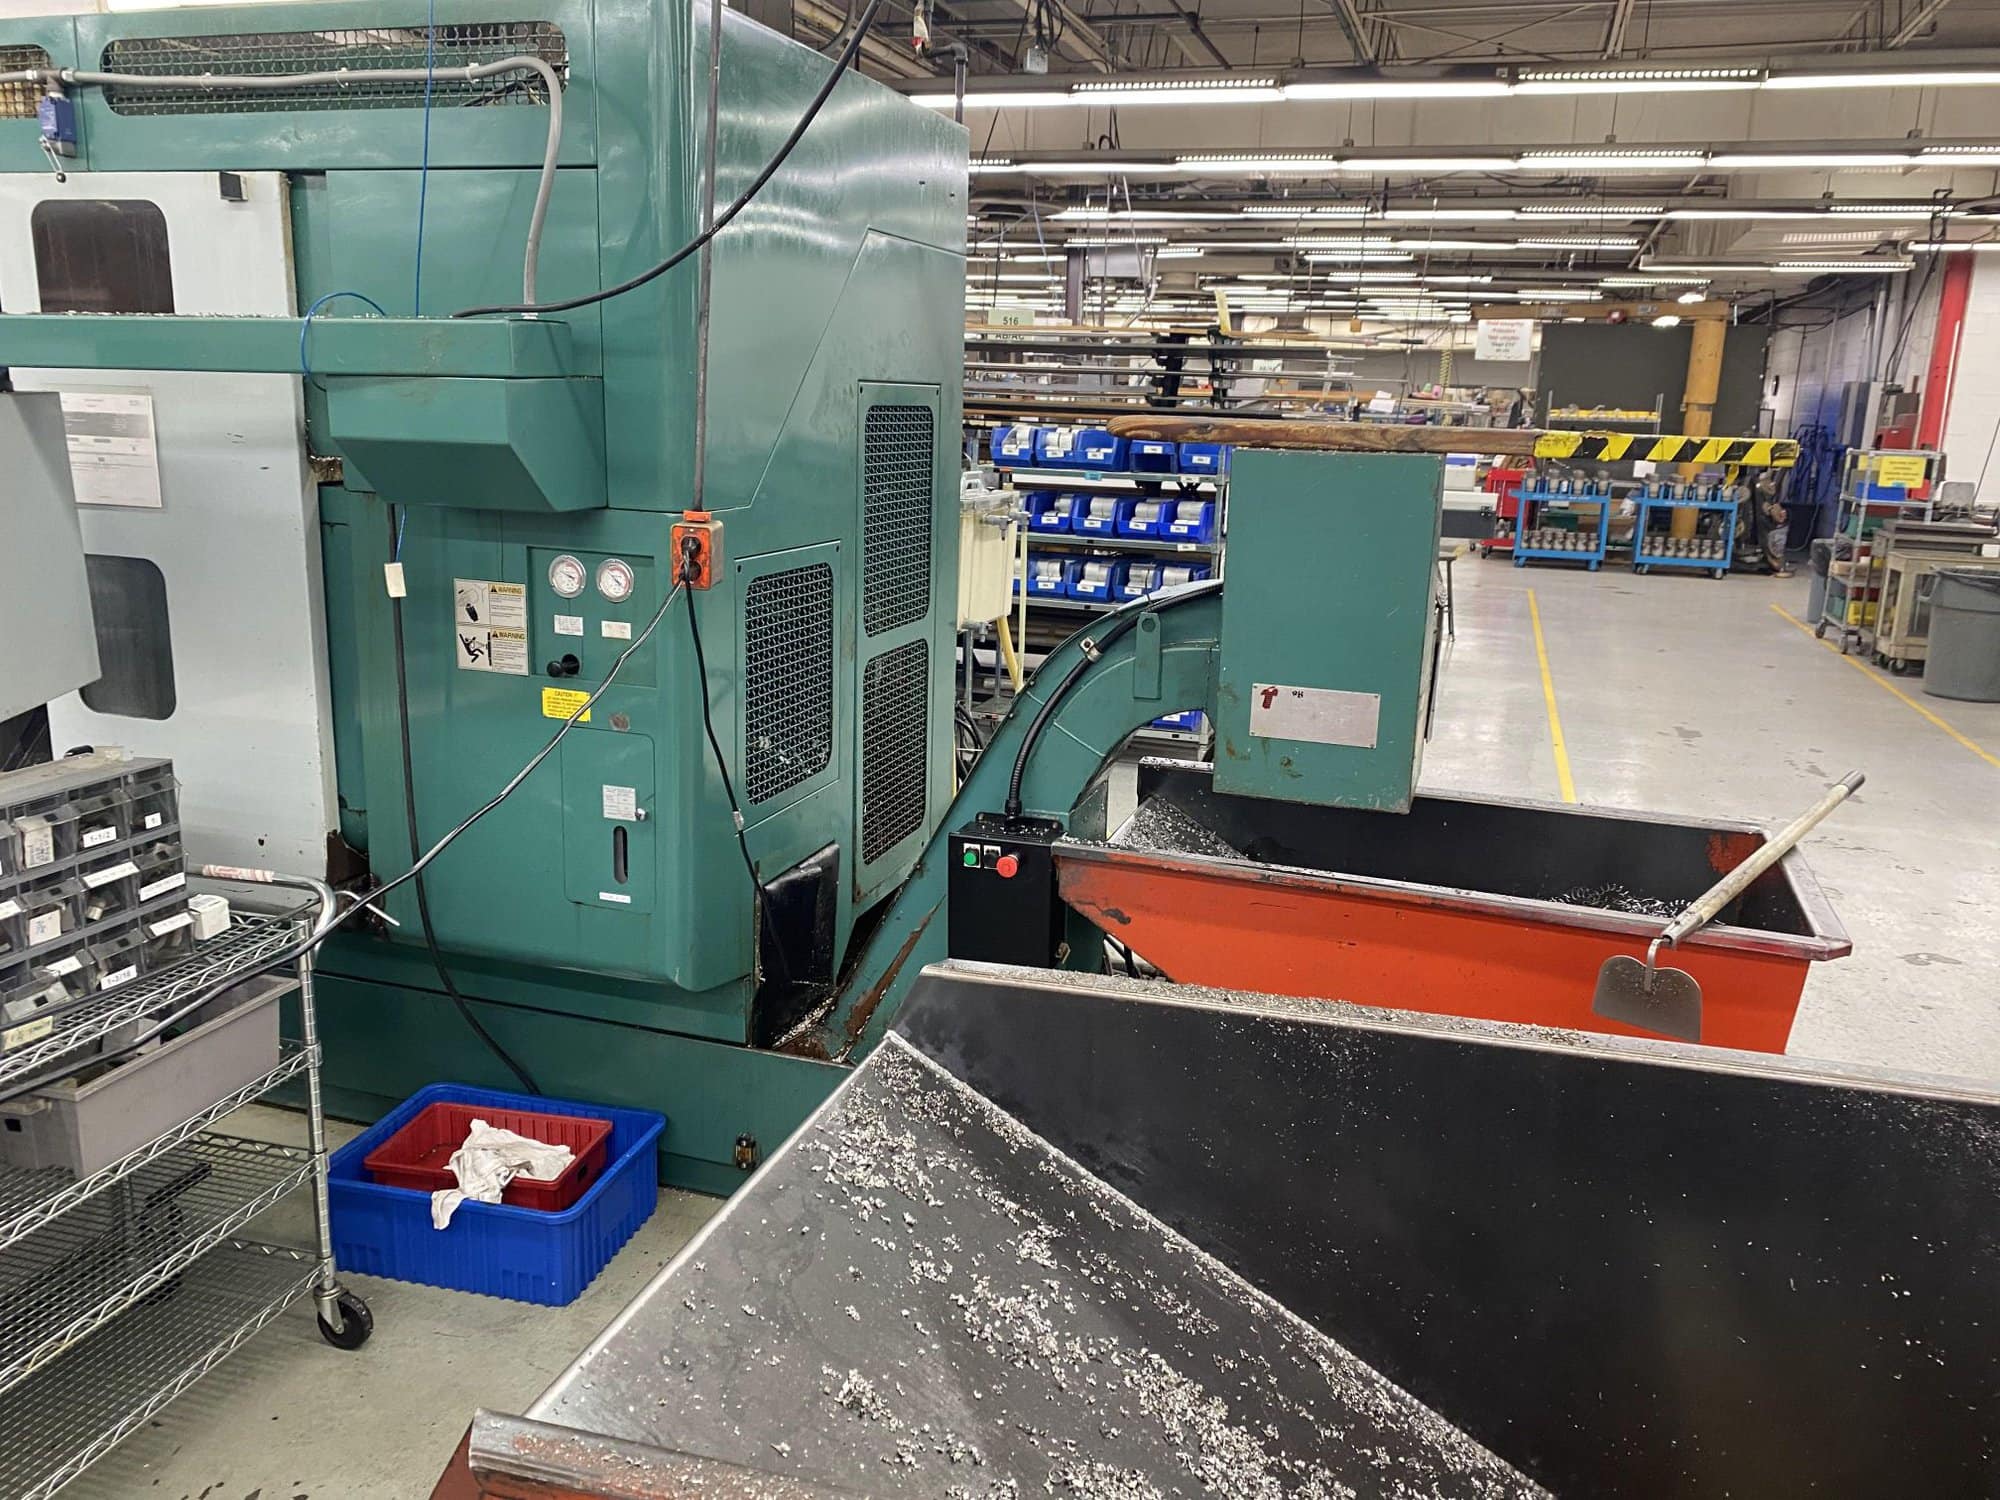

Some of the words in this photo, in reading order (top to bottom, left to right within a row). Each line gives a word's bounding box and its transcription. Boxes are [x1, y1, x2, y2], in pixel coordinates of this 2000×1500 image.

[1002, 316, 1019, 326] 516
[498, 586, 522, 595] WARNING
[499, 631, 525, 640] WARNING
